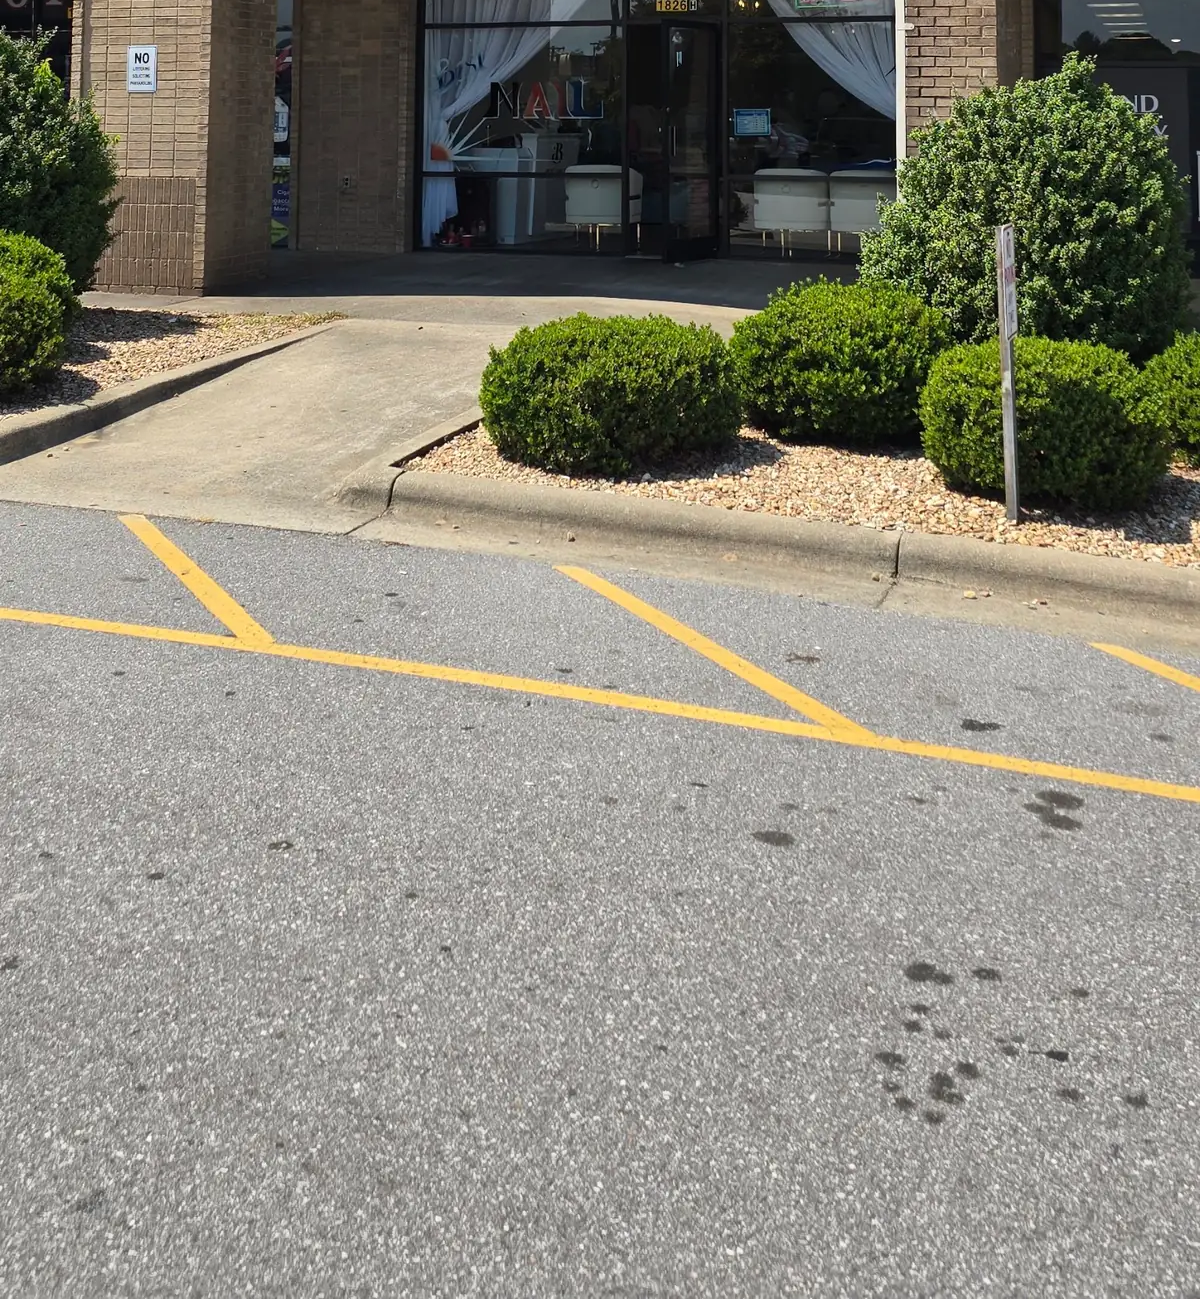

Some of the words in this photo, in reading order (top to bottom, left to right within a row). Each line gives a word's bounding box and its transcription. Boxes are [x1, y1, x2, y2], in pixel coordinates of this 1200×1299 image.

[657, 0, 687, 11] 1826
[134, 52, 150, 64] NO
[483, 81, 604, 119] NAIL
